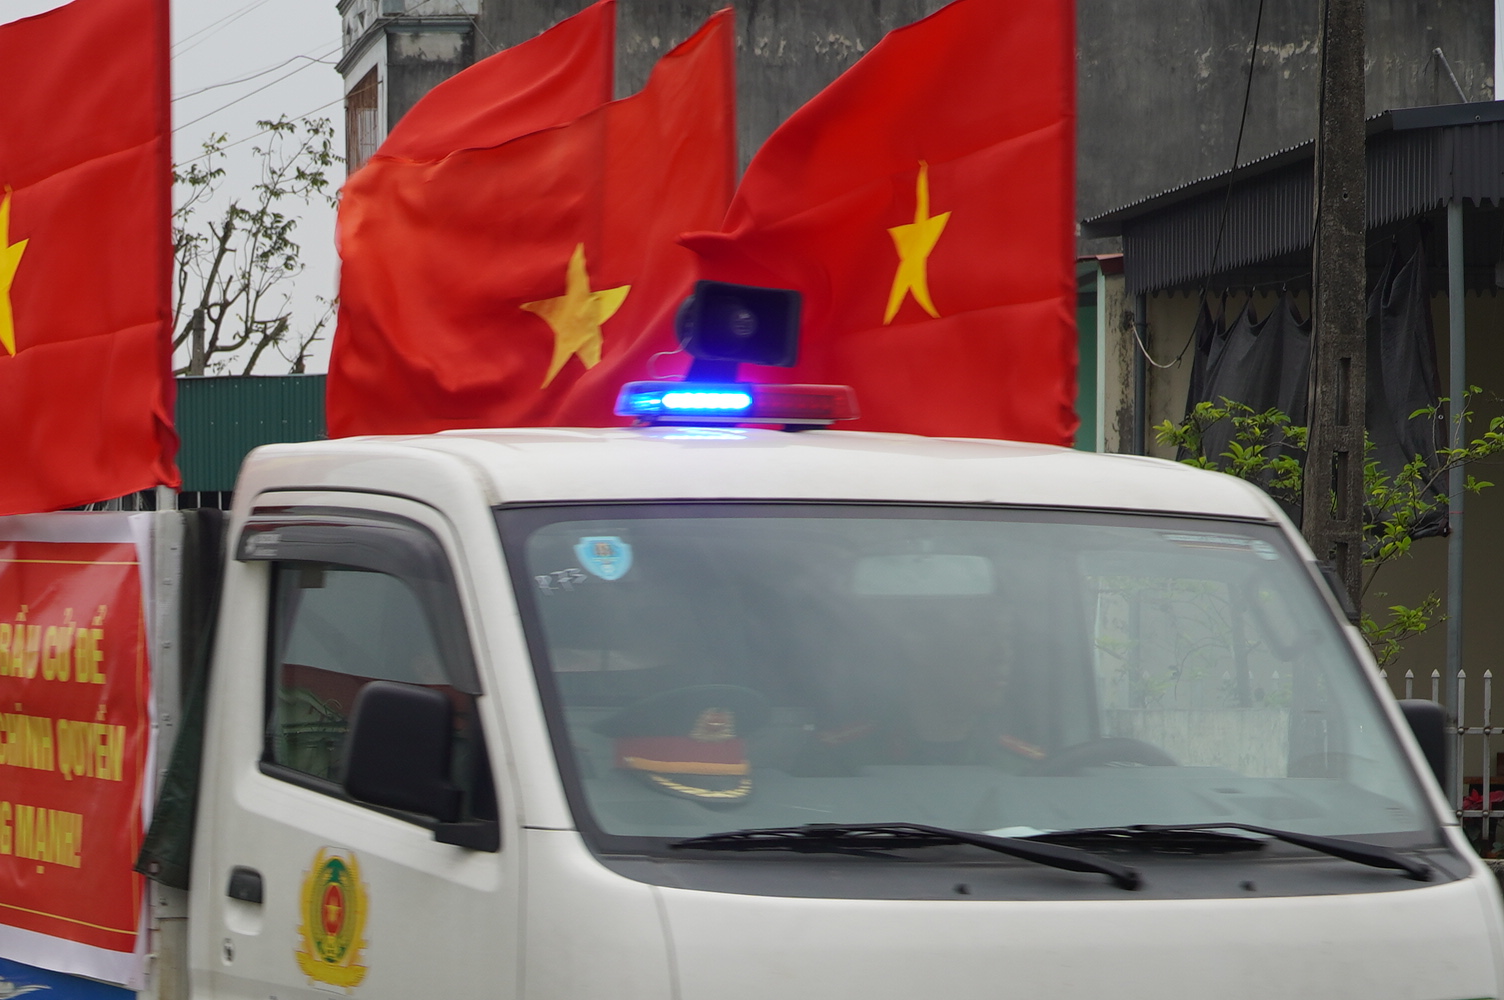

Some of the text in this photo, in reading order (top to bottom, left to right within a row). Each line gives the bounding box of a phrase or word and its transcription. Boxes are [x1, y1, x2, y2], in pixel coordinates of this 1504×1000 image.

[42, 608, 77, 682] CỬ
[75, 605, 107, 685] ĐỂ
[56, 704, 126, 781] QUYỀN
[15, 804, 83, 874] MẠNH!
